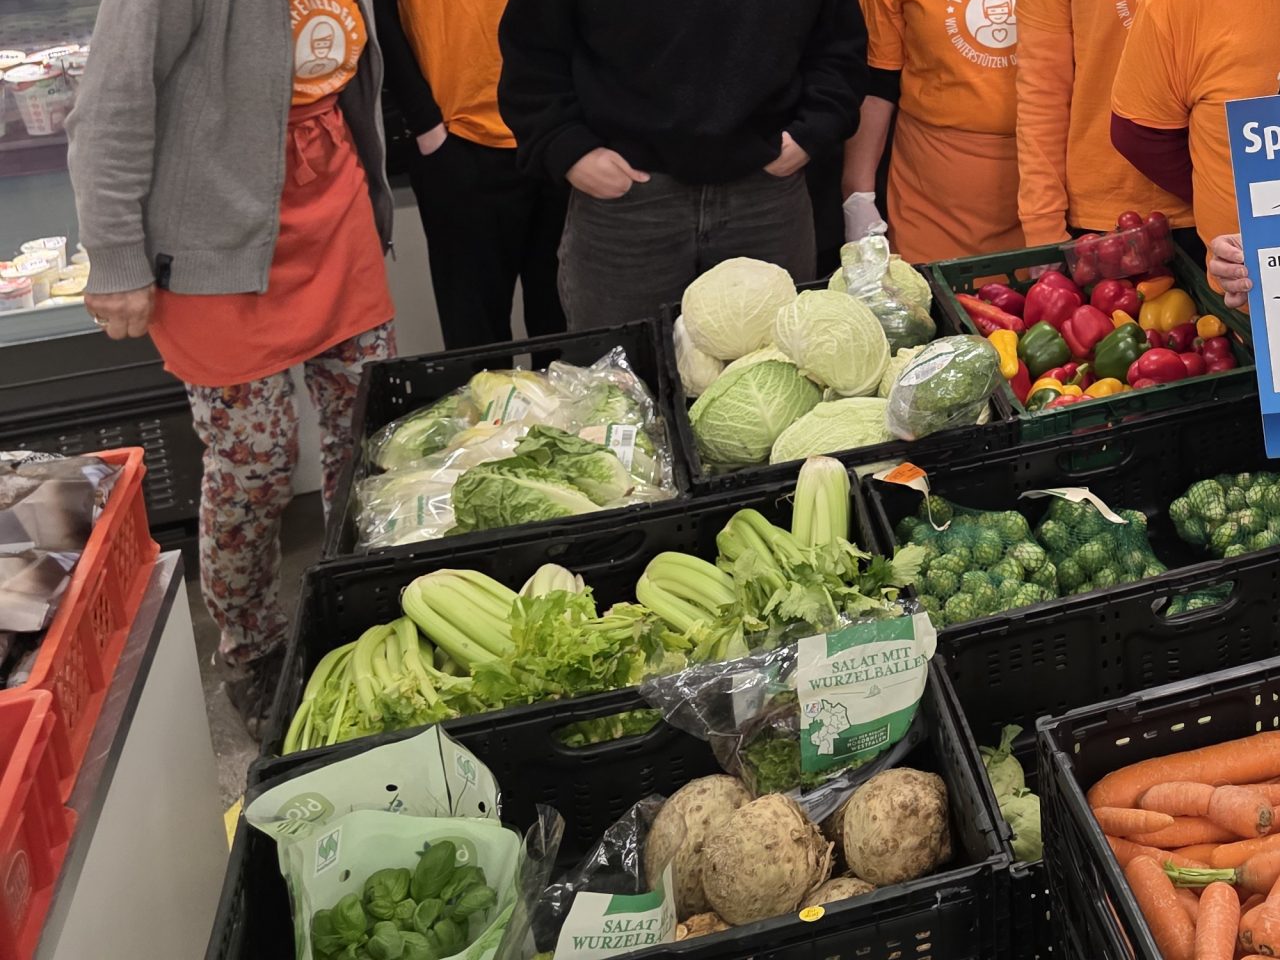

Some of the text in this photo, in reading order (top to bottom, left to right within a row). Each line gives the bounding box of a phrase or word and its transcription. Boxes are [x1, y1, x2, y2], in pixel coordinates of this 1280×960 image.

[1116, 0, 1130, 19] WIR
[945, 17, 958, 36] WIR
[832, 646, 912, 674] SALAT MIT
[602, 919, 658, 933] SALAT
